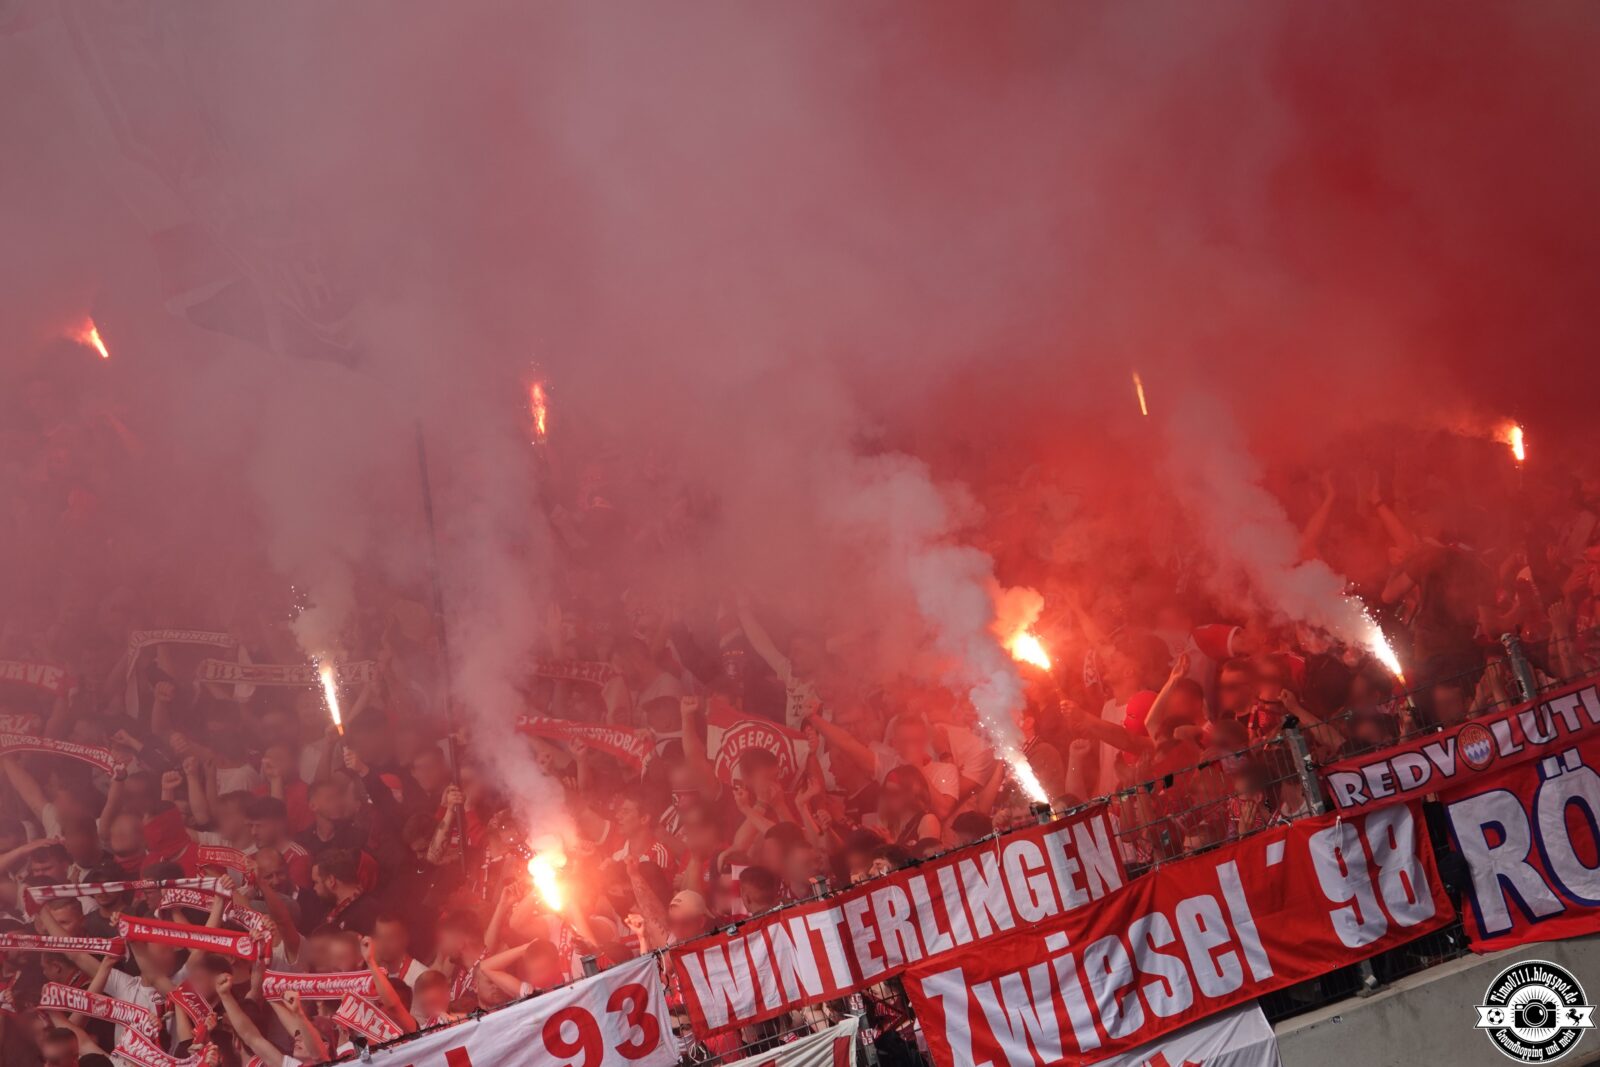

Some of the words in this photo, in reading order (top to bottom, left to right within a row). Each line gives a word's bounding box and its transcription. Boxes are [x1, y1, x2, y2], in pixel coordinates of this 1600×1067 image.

[40, 983, 89, 1011] BAYERN
[681, 814, 1124, 1030] WINTERLINGEN
[920, 859, 1274, 1067] Zwiesel
